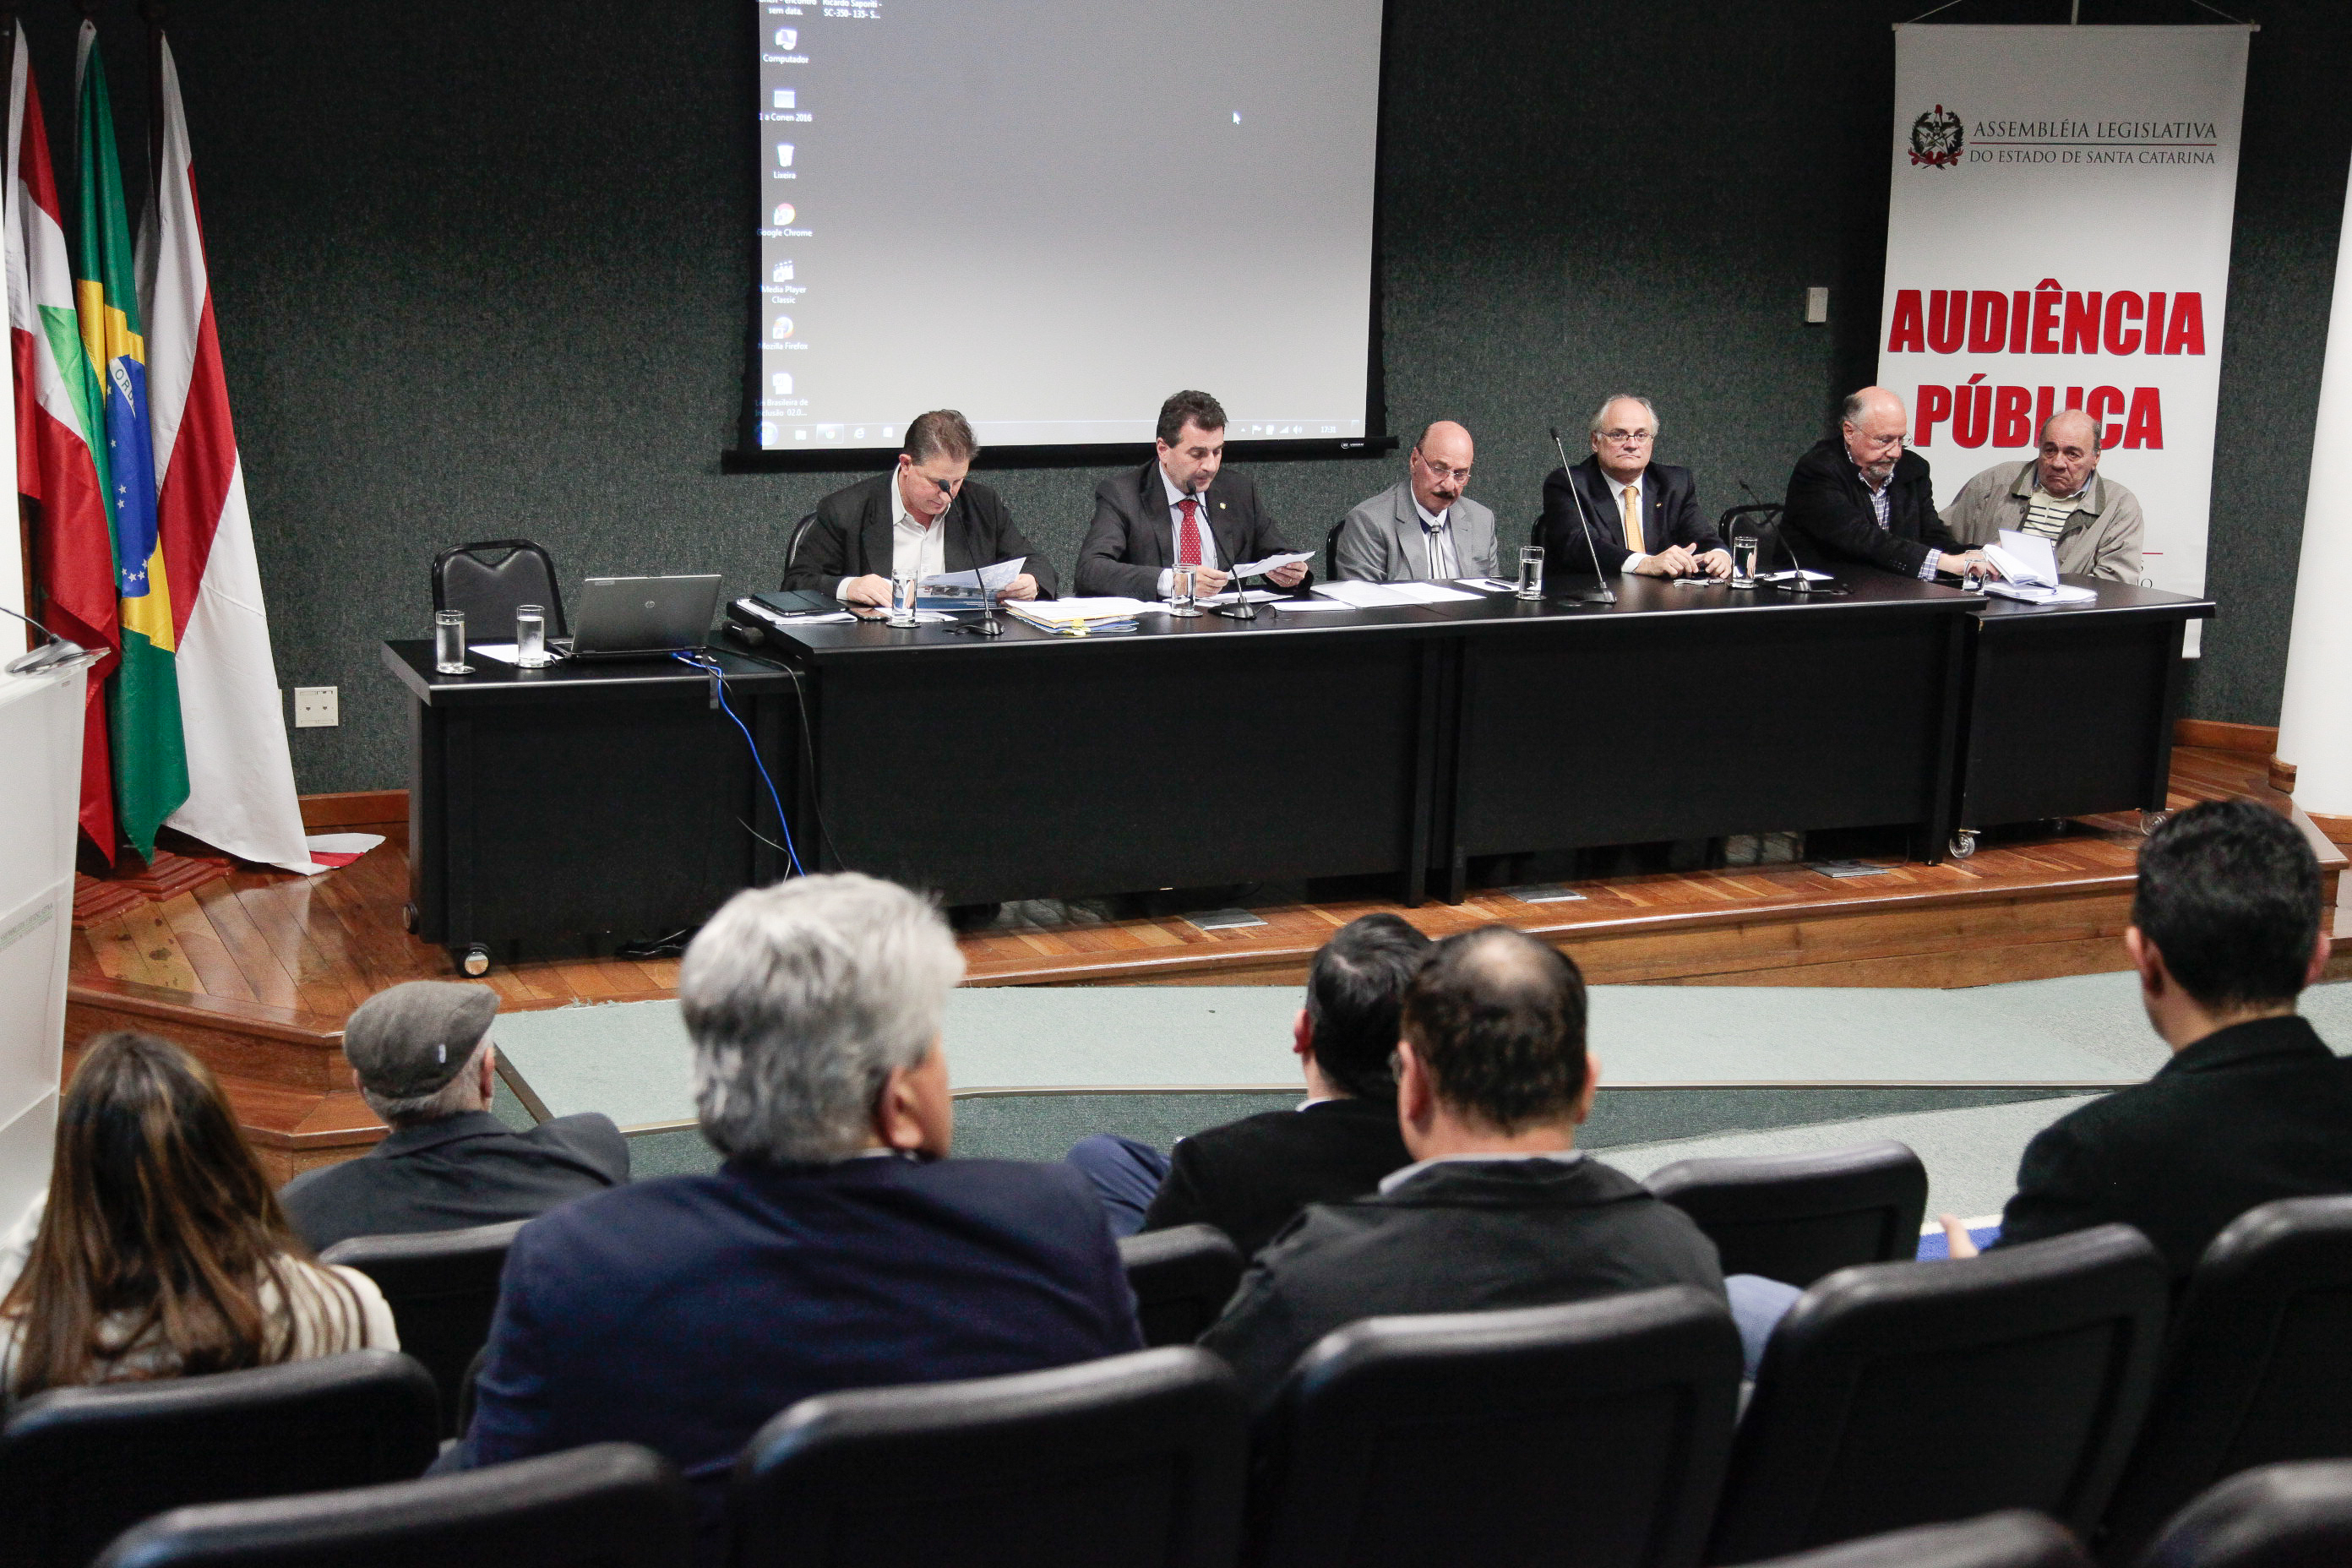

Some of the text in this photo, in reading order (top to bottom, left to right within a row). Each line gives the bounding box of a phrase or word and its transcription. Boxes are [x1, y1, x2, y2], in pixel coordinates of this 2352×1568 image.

[762, 54, 809, 64] Computador
[795, 113, 813, 122] 2016
[1973, 118, 2217, 139] ASSEMBLÉIA LEGISLATIVA
[1970, 150, 2215, 164] DO ESTADO DE SANTA CATARINA
[773, 171, 796, 179] Lixeira
[783, 228, 813, 237] Chrome
[785, 286, 806, 295] Player
[771, 296, 796, 304] Classic
[1887, 278, 2206, 356] AUDIÊNCIA
[785, 341, 808, 350] Firefox
[767, 398, 798, 406] Brasileira
[799, 398, 808, 406] de
